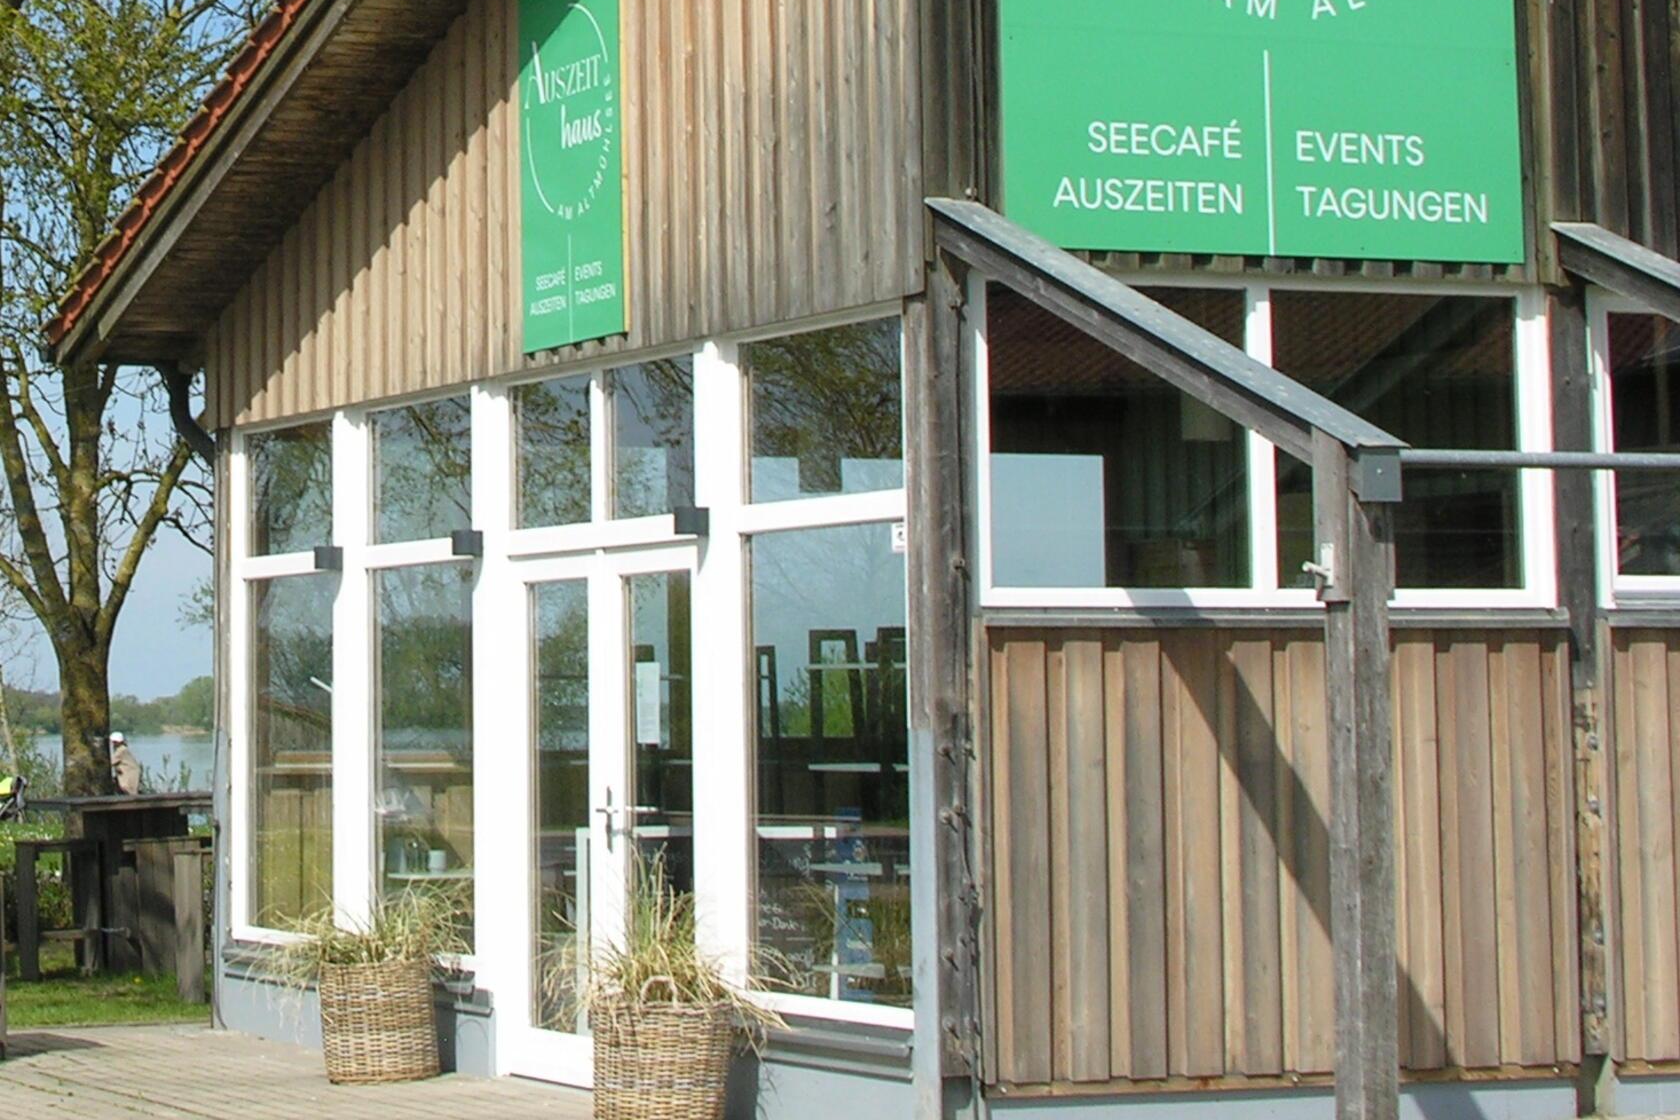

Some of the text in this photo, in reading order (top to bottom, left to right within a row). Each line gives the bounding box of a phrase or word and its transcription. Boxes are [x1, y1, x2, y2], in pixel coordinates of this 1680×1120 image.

[560, 103, 602, 150] haus
[1088, 119, 1243, 159] SEECAFÉ
[1296, 130, 1425, 166] EVENTS
[1053, 176, 1244, 214] AUSZEITEN
[1296, 185, 1488, 224] TAGUNGEN
[574, 260, 603, 282] EVENTS
[574, 282, 616, 304] TAGUNGEN
